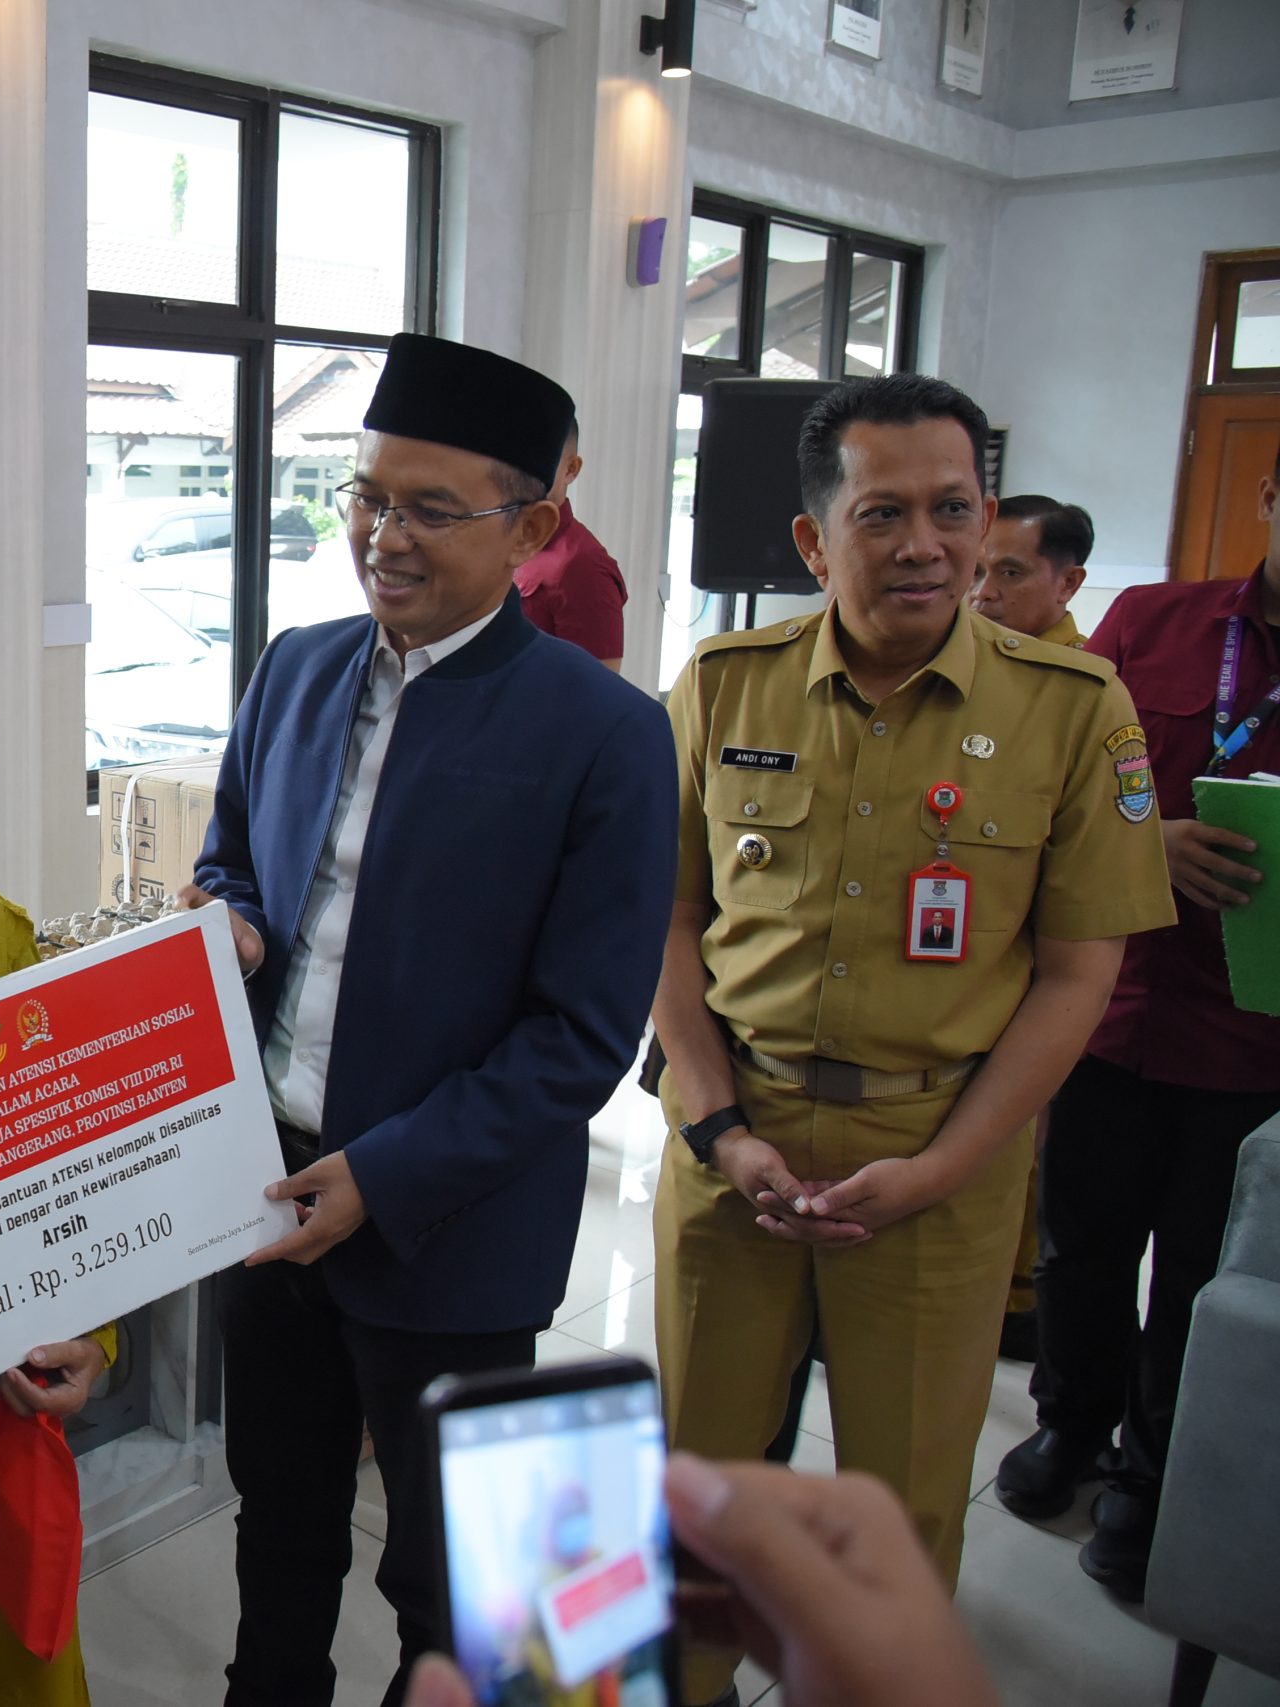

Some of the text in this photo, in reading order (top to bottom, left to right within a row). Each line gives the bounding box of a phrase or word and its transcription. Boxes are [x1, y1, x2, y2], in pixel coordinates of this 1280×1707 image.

[1221, 662, 1234, 684] TEAM,
[1223, 646, 1235, 661] ONE
[1218, 685, 1230, 701] ONE
[735, 753, 780, 766] ANDI ONY
[9, 1056, 57, 1088] ATENSI
[57, 1020, 150, 1068] KEMENTERIAN
[151, 1003, 195, 1030] SOSIAL
[14, 1099, 73, 1134] SPESIFIK
[73, 1080, 120, 1110] KOMISI
[119, 1070, 144, 1090] VIII
[143, 1061, 169, 1082] DPR
[169, 1054, 183, 1071] RI
[35, 1073, 80, 1102] ACARA
[75, 1097, 137, 1134] PROVINSI
[136, 1075, 187, 1108] BANTEN
[51, 1157, 94, 1187] ATENSI
[96, 1130, 157, 1167] Kelompok
[159, 1103, 222, 1139] Disabilitas
[5, 1201, 51, 1232] Dengar
[54, 1190, 79, 1210] dan
[81, 1143, 181, 1198] Kewirausahaan)
[42, 1213, 89, 1249] Arsih
[187, 1242, 209, 1256] Sentra
[227, 1227, 242, 1238] Jaya
[242, 1216, 266, 1232] Jakarta
[29, 1269, 68, 1299] Rp.
[71, 1212, 173, 1278] 3.259.100
